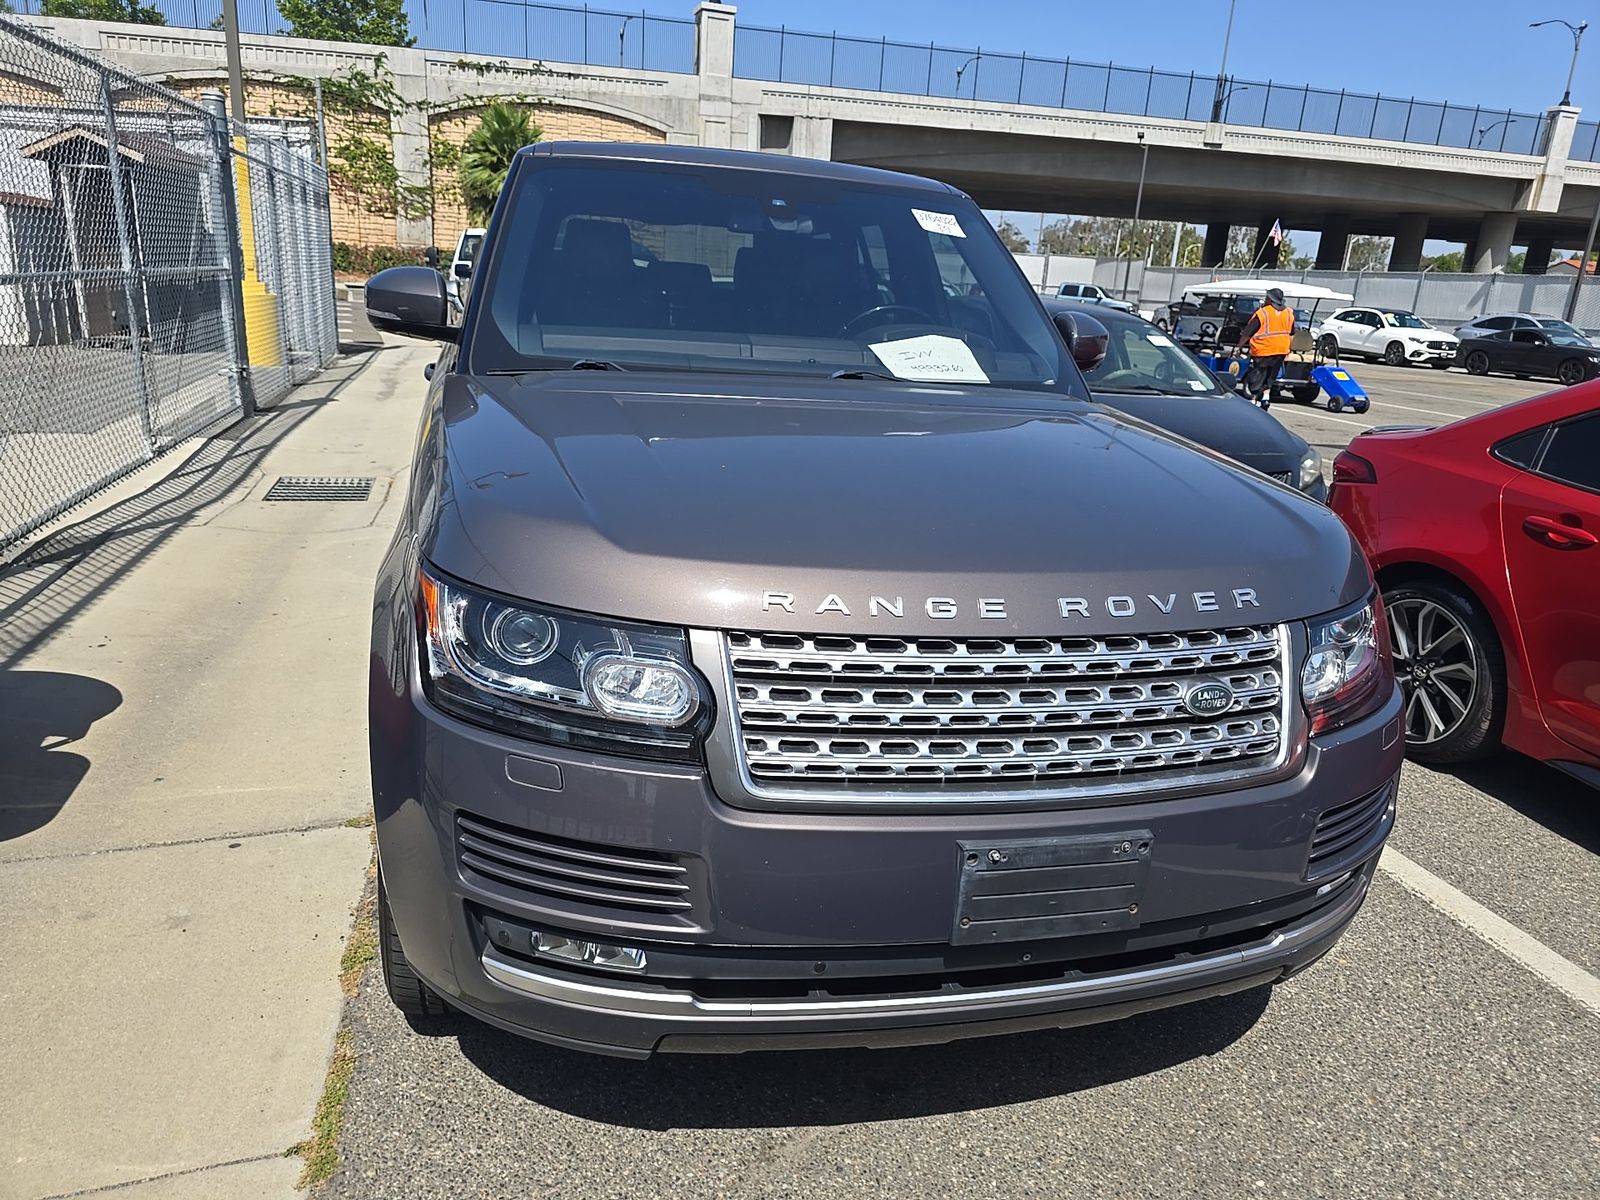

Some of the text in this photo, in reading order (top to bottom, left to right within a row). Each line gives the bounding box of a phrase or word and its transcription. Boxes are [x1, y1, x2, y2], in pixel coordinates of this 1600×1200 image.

[761, 587, 1261, 620] RANGE ROVER
[1197, 690, 1220, 700] LAND
[1200, 698, 1227, 708] ROVER
